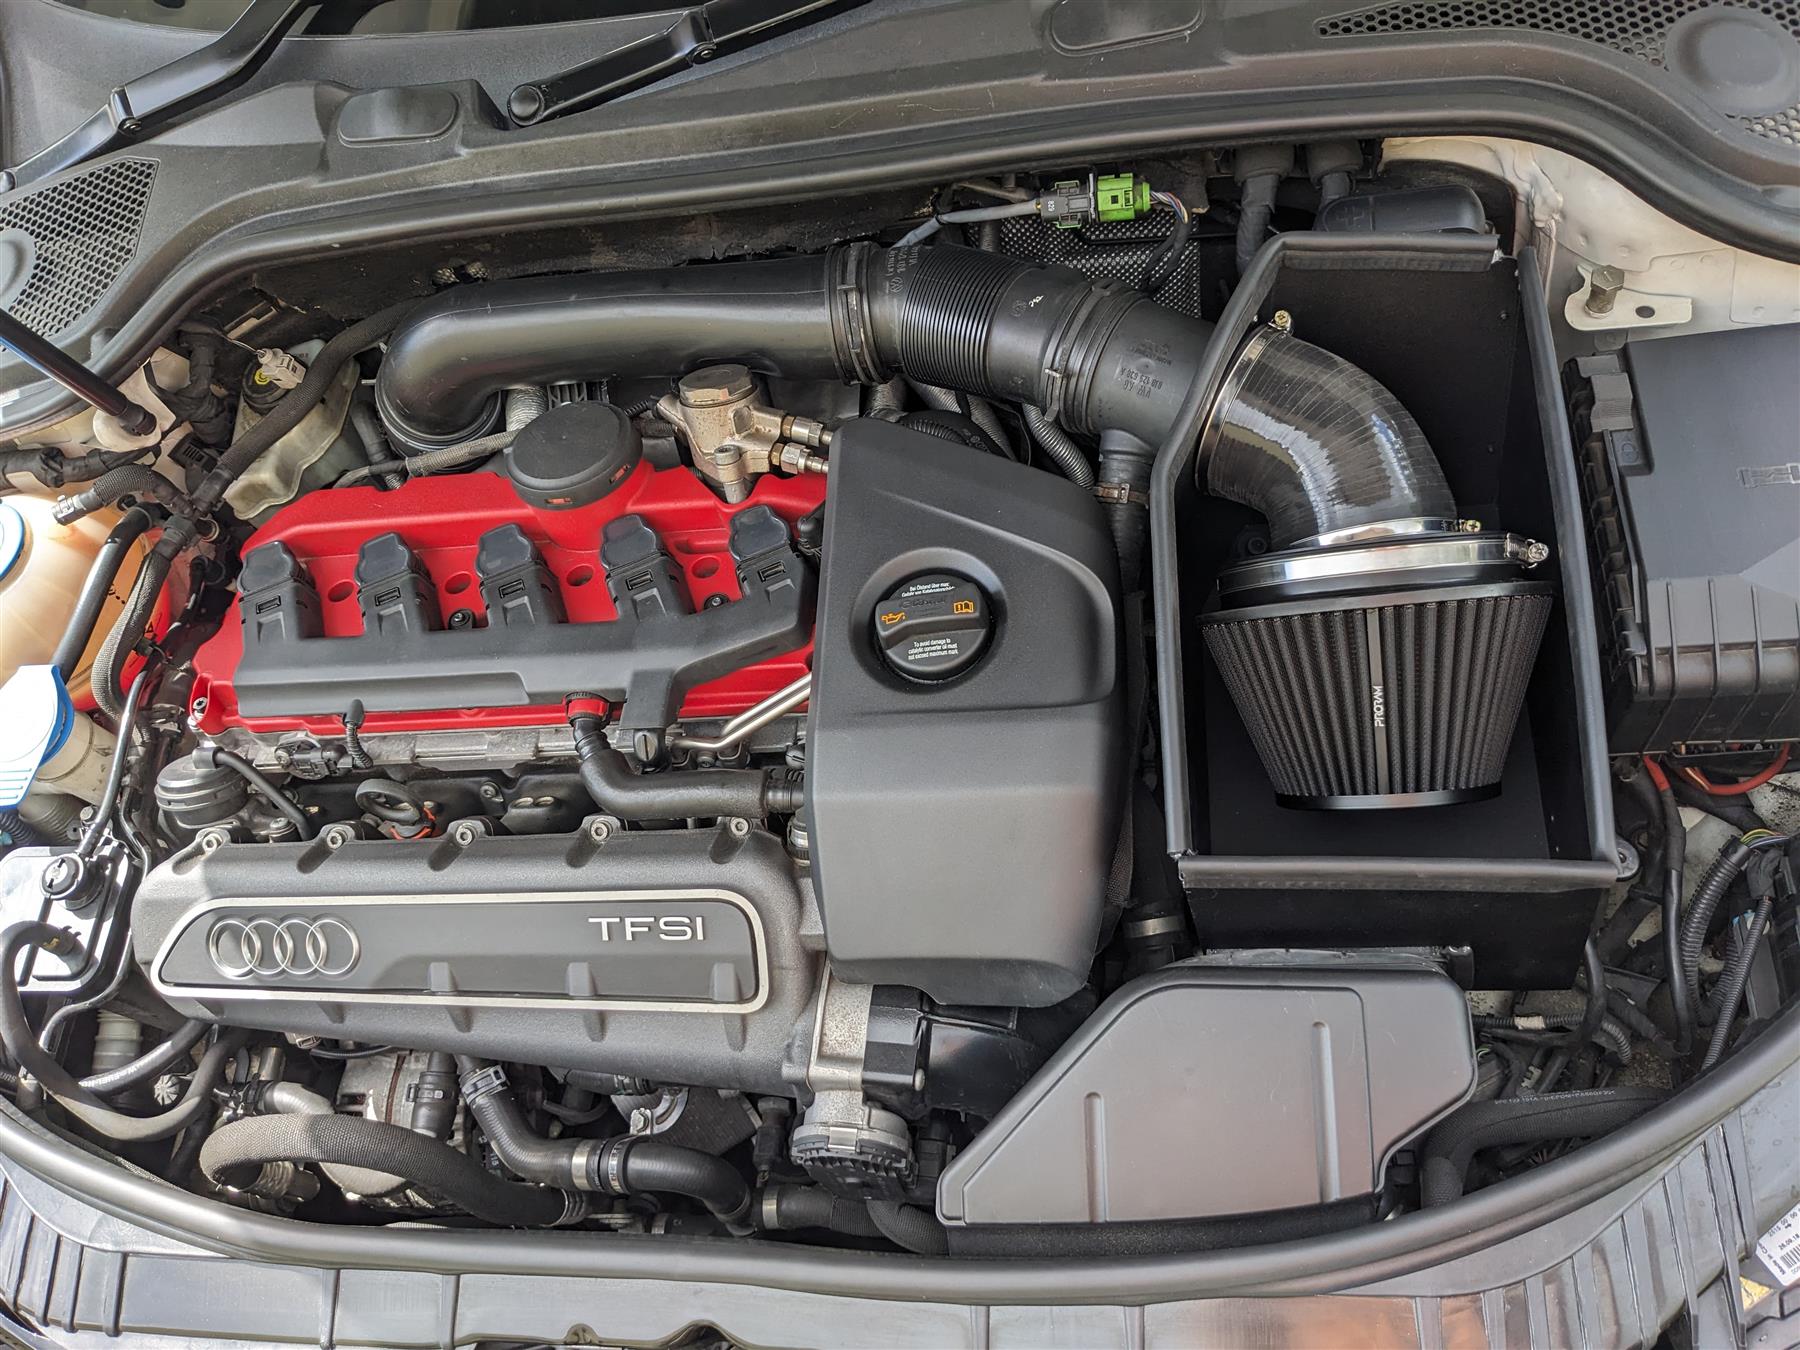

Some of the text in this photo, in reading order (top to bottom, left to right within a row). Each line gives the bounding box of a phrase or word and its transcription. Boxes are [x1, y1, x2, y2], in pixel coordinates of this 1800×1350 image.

[908, 647, 924, 655] catalytic
[1372, 685, 1385, 727] PRORAM
[588, 916, 705, 941] TFSI
